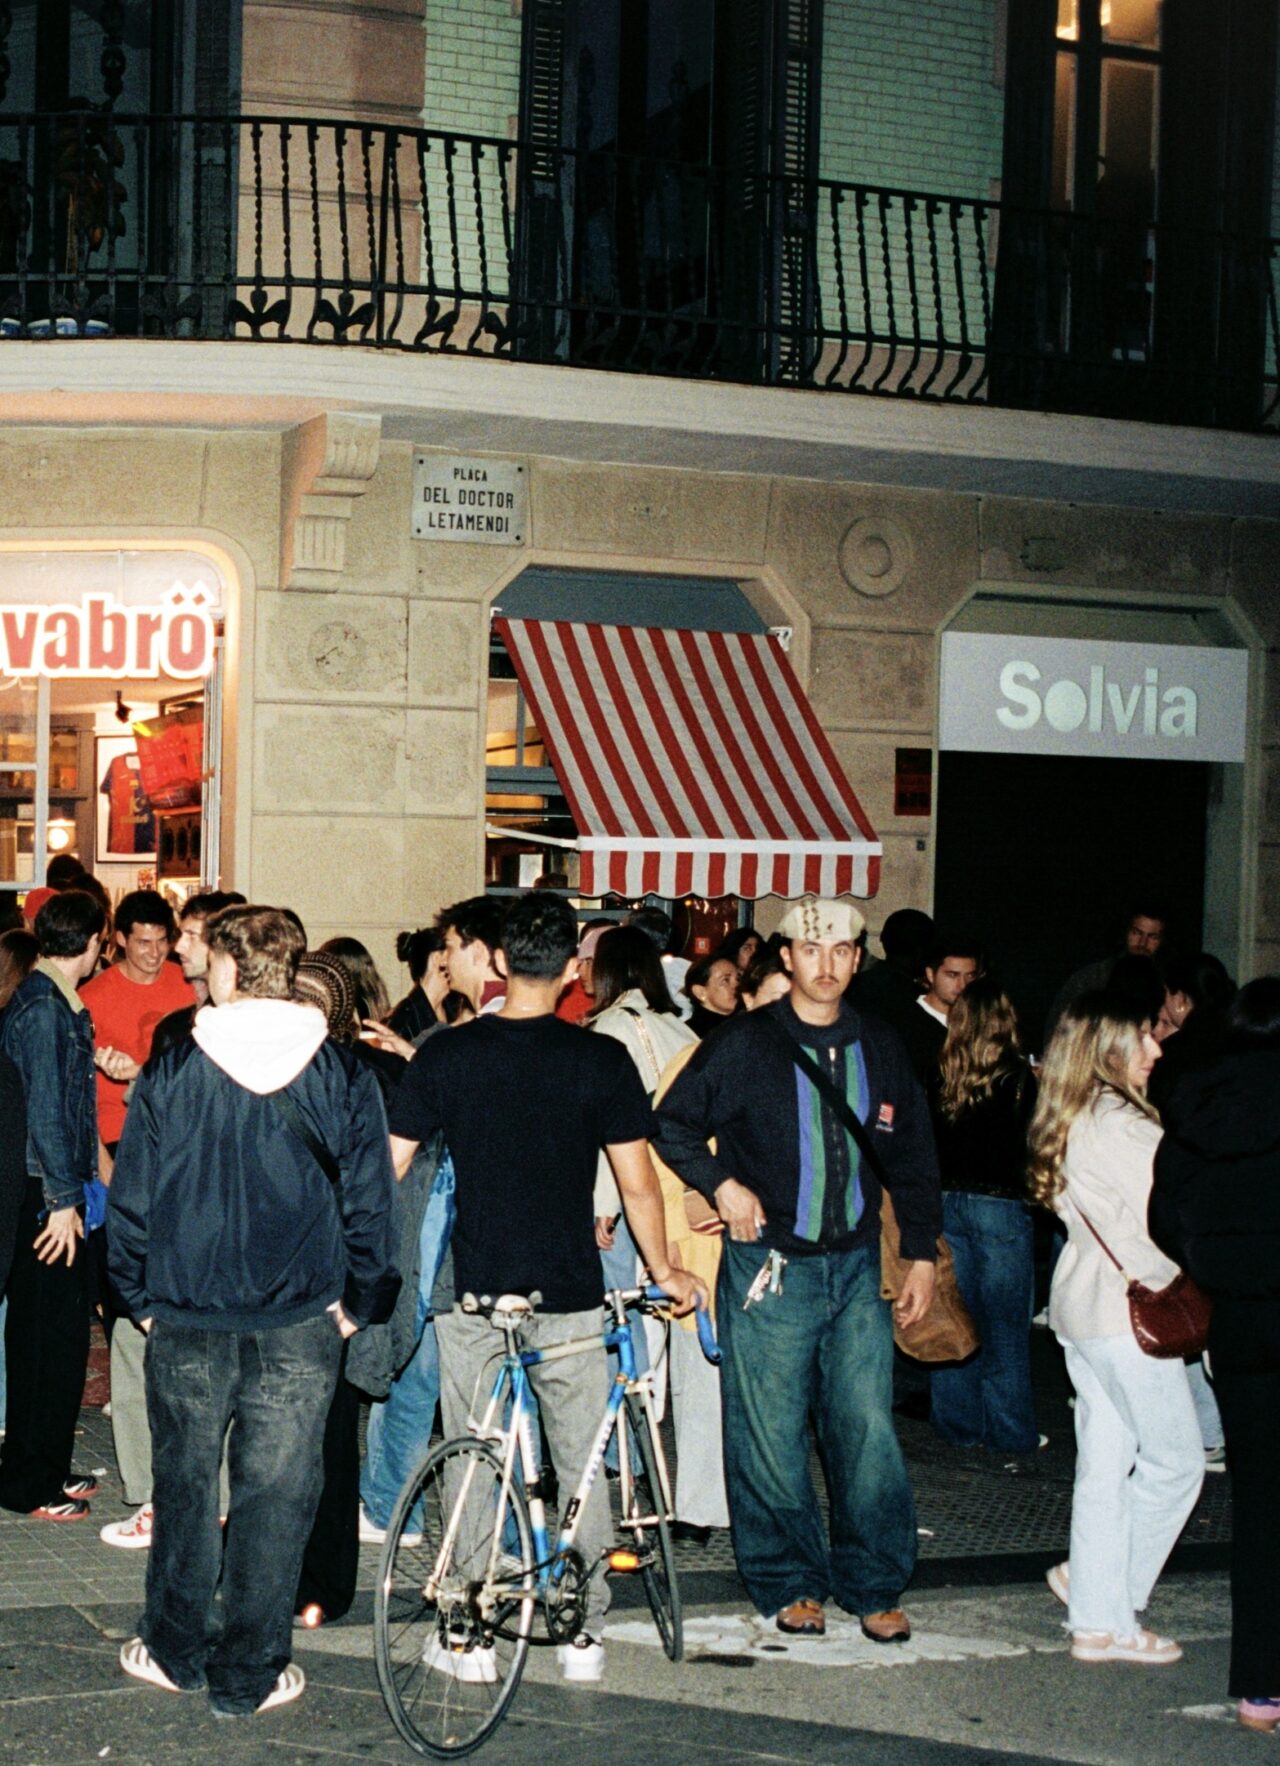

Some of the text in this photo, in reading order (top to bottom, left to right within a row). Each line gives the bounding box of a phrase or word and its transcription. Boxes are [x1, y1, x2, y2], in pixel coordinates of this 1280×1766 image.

[453, 467, 488, 482] PLAÇA
[423, 486, 514, 509] DEL DOCTOR
[428, 511, 509, 533] LETAMENDI
[995, 659, 1198, 738] Solvia
